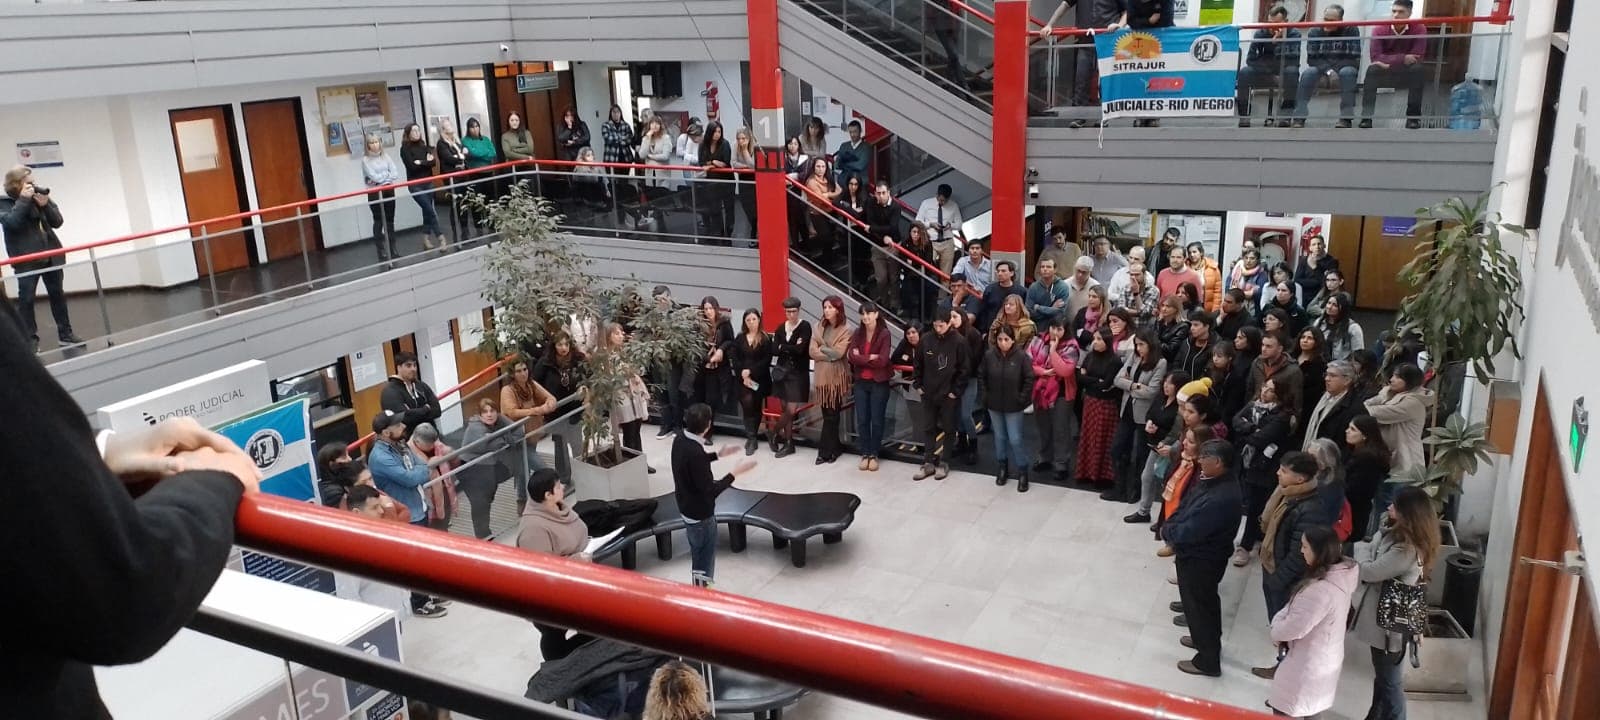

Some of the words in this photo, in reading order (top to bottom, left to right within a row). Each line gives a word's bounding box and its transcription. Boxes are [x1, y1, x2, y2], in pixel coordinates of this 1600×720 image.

[1113, 61, 1166, 72] SITRAJUR
[1193, 99, 1233, 110] NEGRO
[758, 116, 770, 139] 1
[200, 389, 245, 411] JUDICIAL
